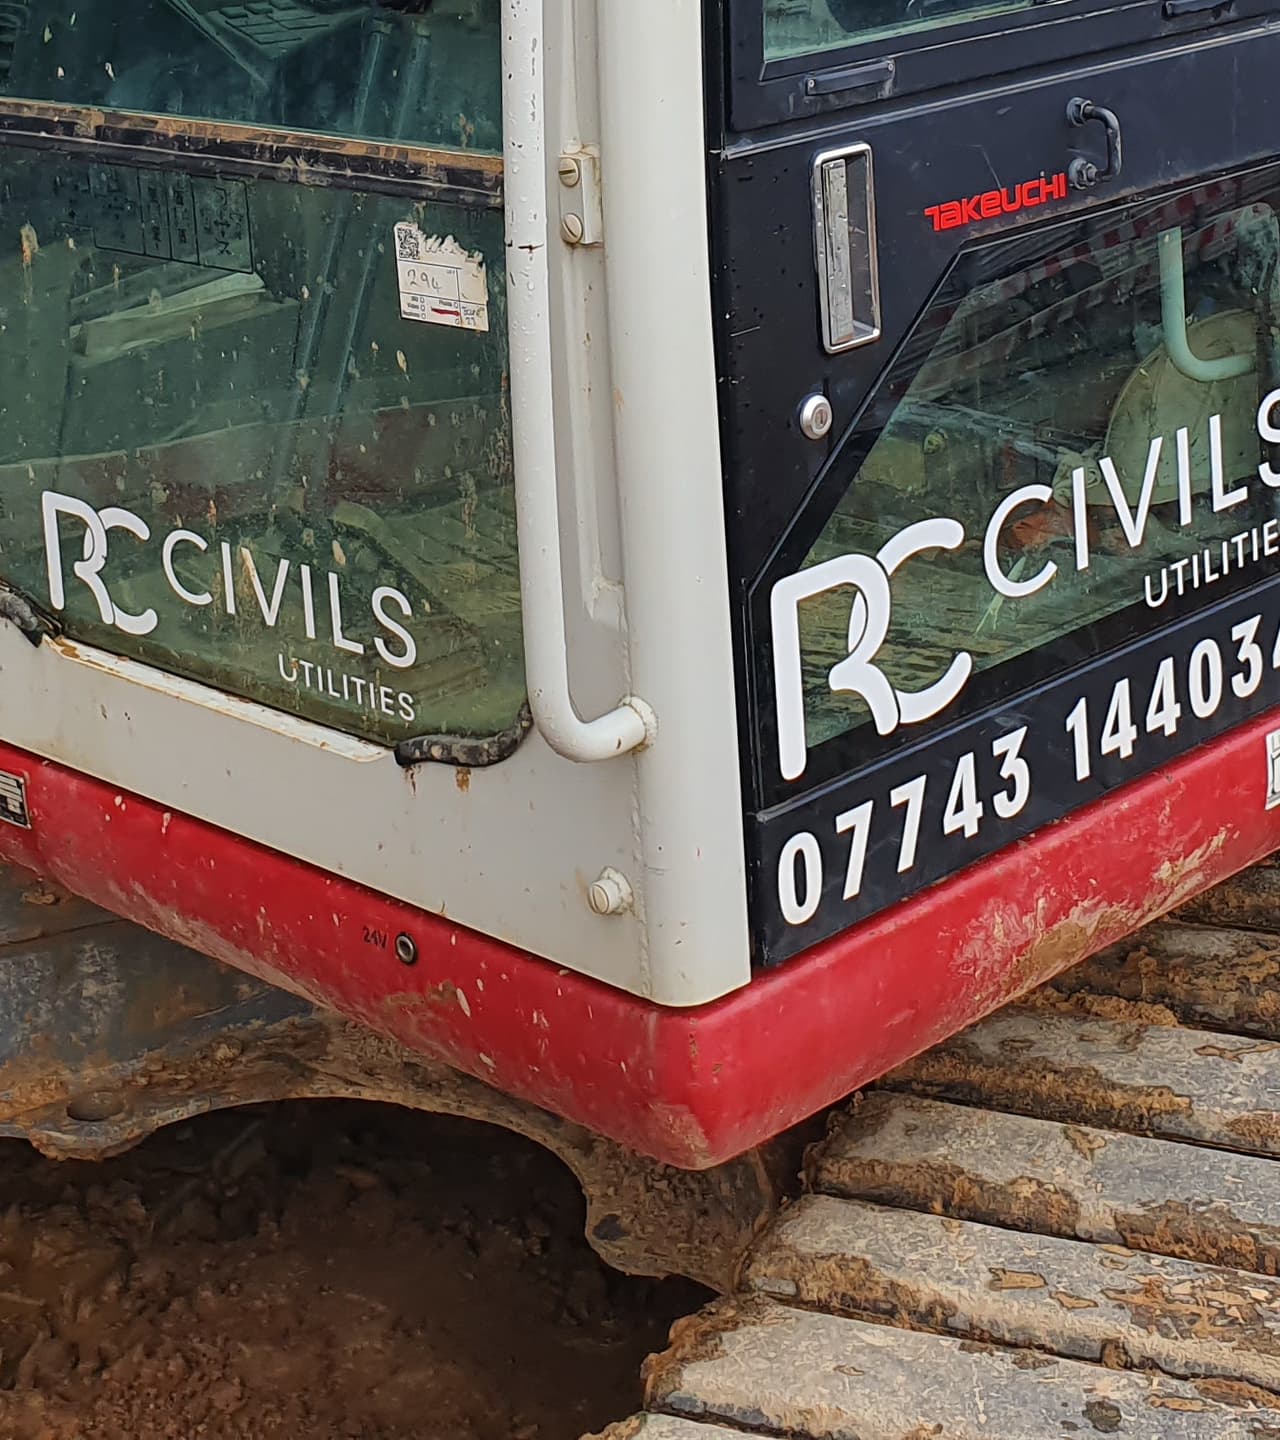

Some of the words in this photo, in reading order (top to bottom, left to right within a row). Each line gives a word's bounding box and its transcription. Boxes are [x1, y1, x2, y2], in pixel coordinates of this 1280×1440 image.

[924, 172, 1067, 231] TAKEUCHI
[41, 490, 158, 635] RC
[161, 528, 418, 669] CIVILS
[277, 652, 417, 723] UTILITIES
[770, 517, 973, 781] RC
[777, 726, 1031, 926] 07743
[363, 925, 388, 948] 24V
